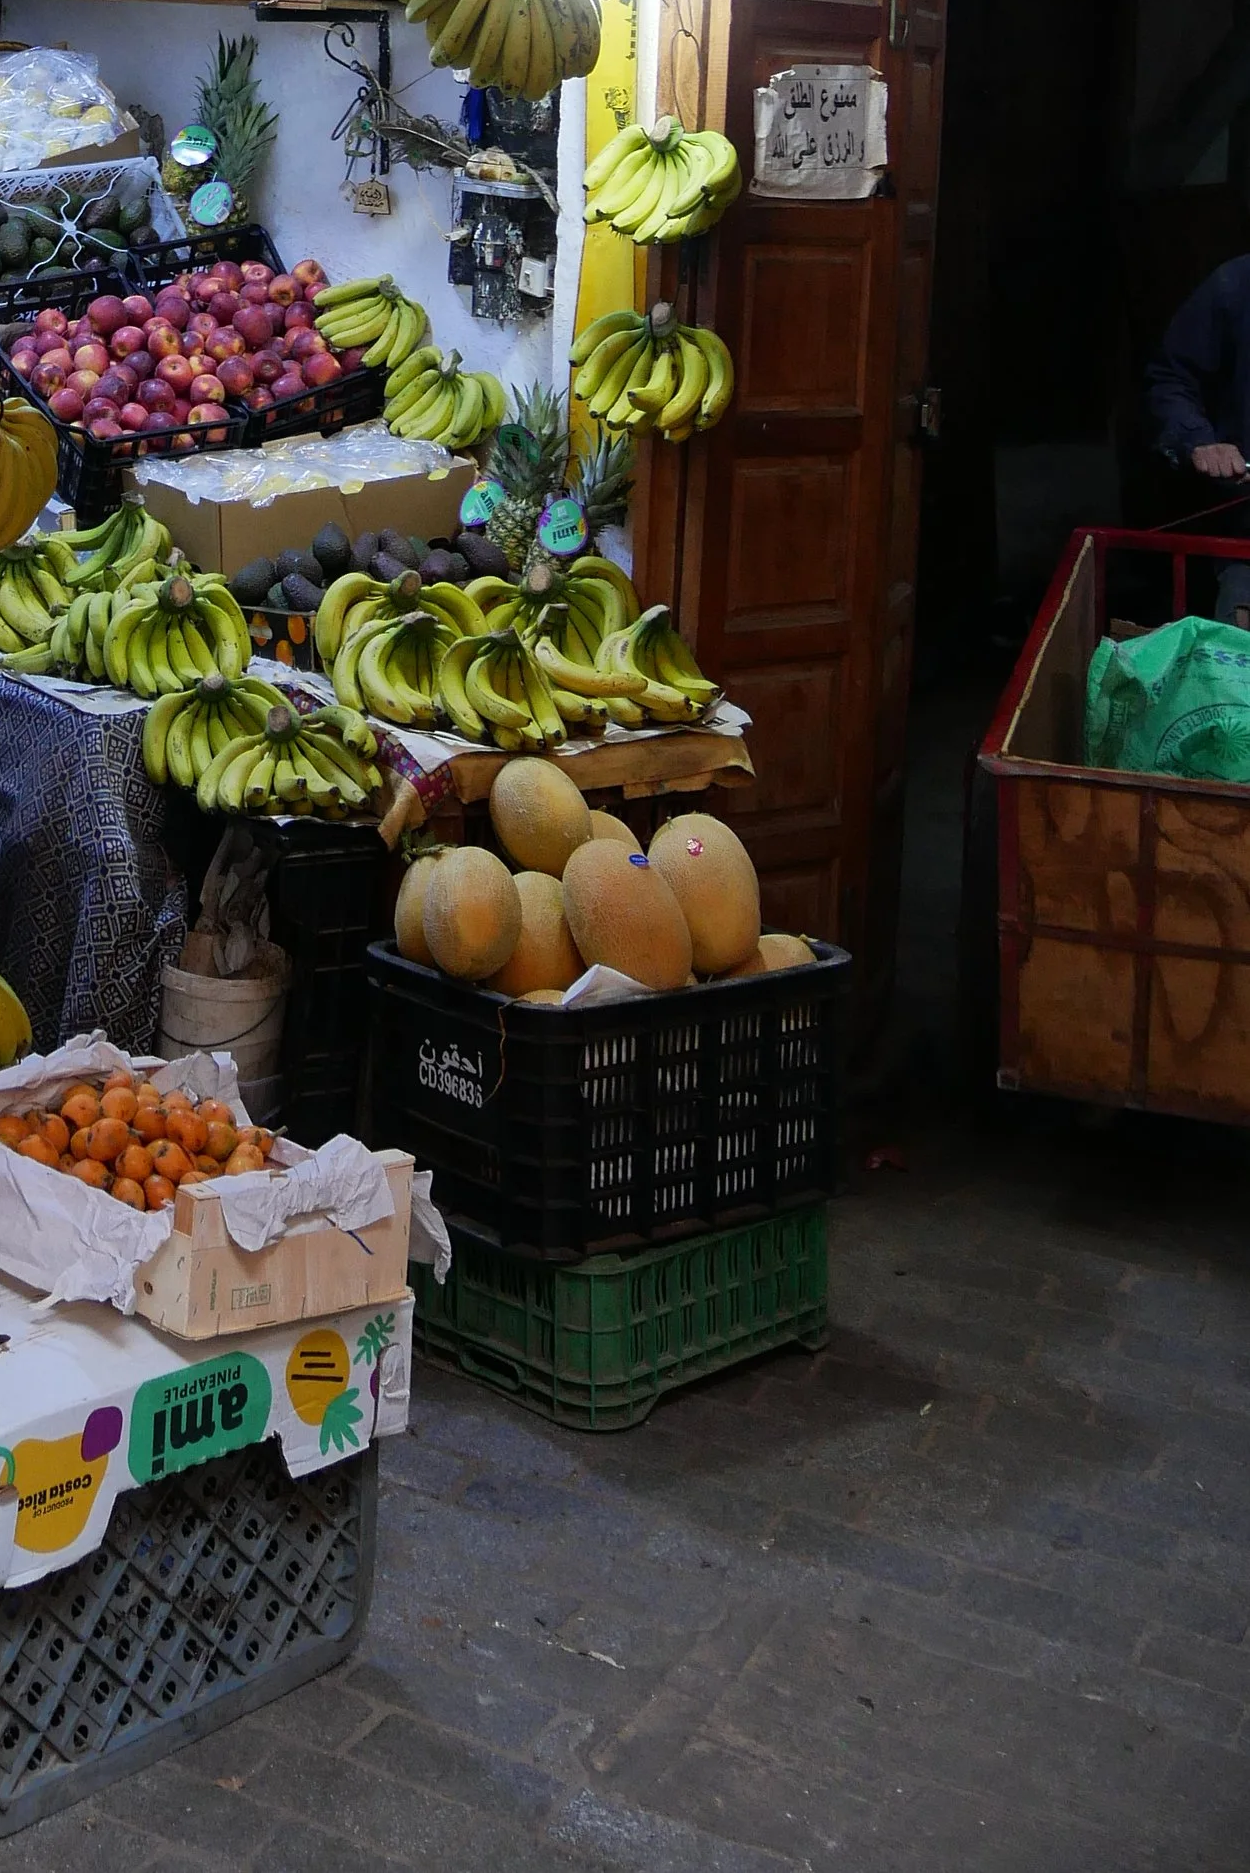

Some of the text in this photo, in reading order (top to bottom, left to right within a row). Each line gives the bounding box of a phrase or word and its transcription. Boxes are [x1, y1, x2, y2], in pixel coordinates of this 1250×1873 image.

[819, 83, 857, 122] ممنوع
[772, 132, 788, 159] الله
[792, 129, 817, 169] على
[163, 1364, 242, 1404] PINEAPPLE
[151, 1382, 249, 1476] ami
[50, 1474, 92, 1499] Costa
[32, 1496, 73, 1518] PRODUCT OF
